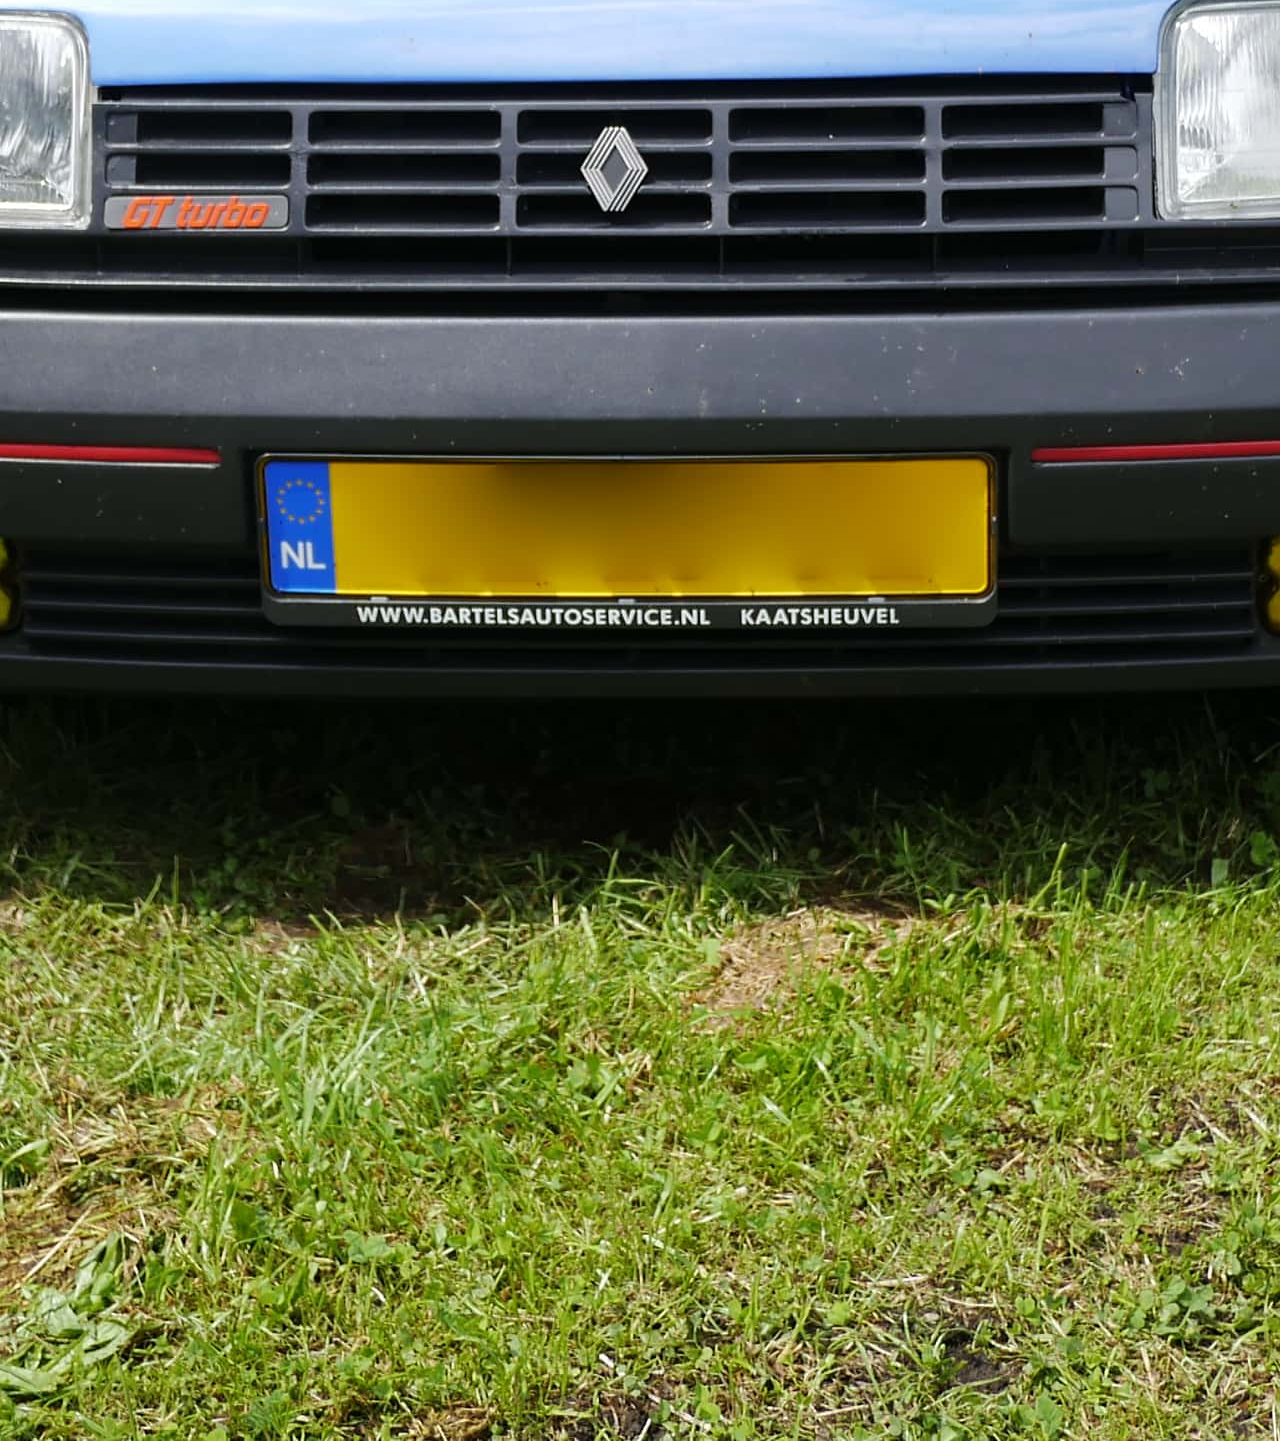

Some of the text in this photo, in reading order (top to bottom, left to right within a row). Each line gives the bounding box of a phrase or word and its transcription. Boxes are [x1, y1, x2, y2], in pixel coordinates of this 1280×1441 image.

[122, 195, 269, 229] GT turbo
[280, 541, 327, 570] NL
[356, 606, 900, 626] WWW.BARTELSAUTOSERVICE.NL KAATSHEUVEL
